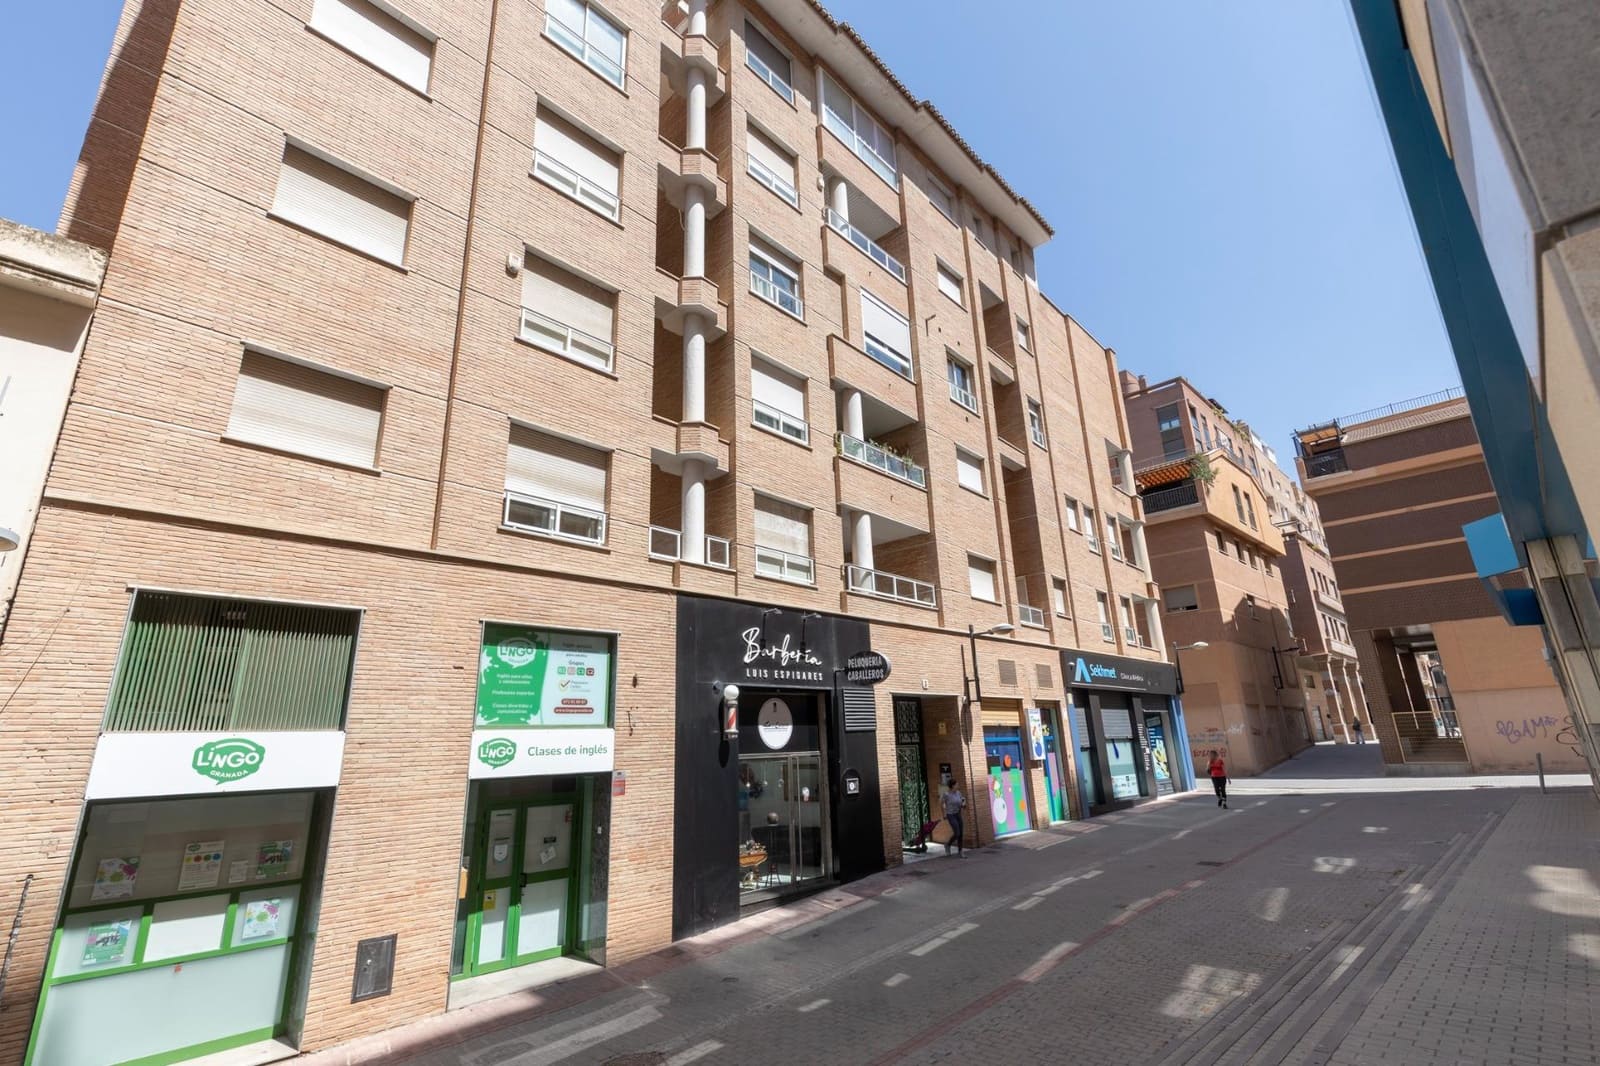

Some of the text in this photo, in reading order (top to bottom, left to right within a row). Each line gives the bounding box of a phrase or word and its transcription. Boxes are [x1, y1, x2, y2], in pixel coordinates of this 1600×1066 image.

[746, 668, 823, 681] LUIS ESPIGARES
[847, 669, 884, 681] CABALLEROS
[1089, 664, 1117, 679] Sekhmet
[527, 743, 608, 757] Clases de inglés
[210, 769, 249, 778] GRANADA
